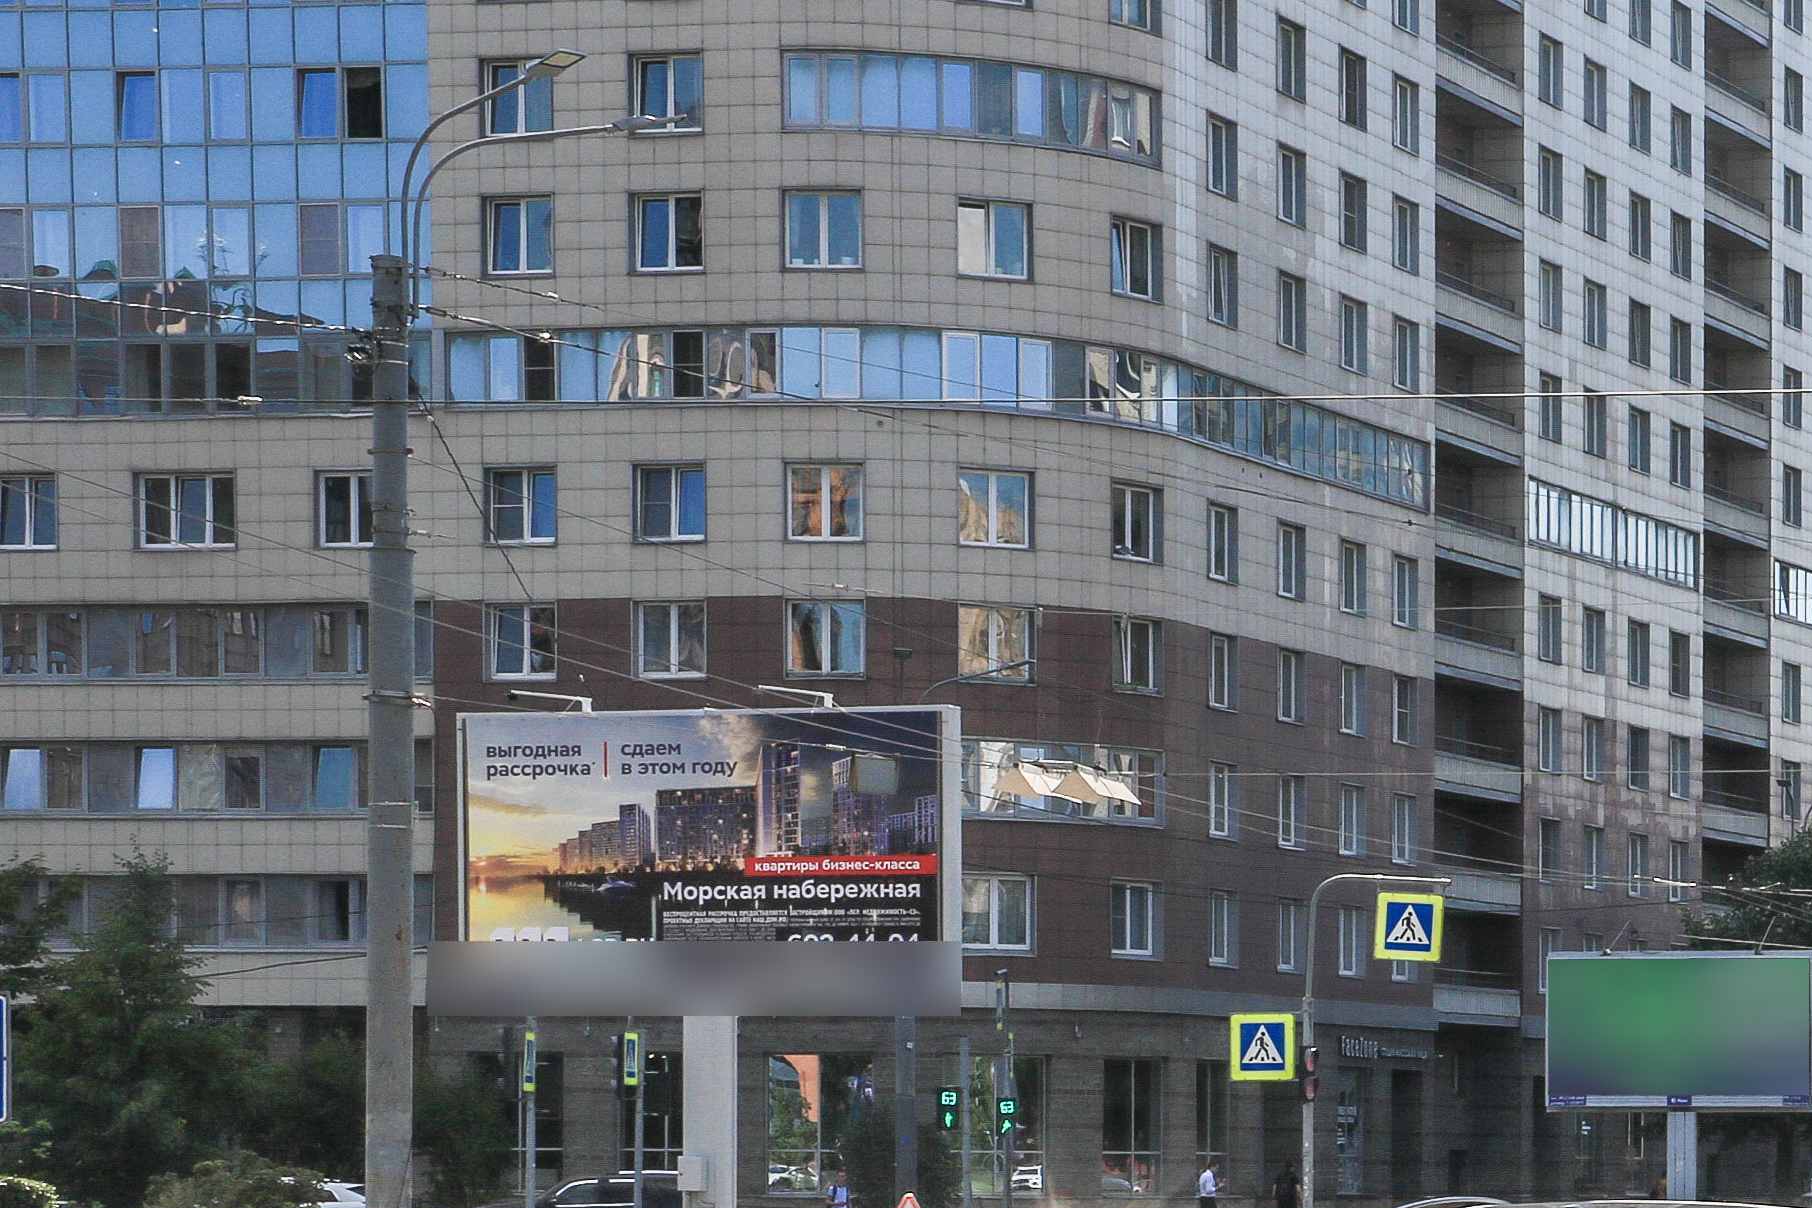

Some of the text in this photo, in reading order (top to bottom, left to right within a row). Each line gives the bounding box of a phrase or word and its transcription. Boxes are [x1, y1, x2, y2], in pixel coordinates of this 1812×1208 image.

[486, 744, 582, 759] выгодная
[621, 742, 682, 758] сдаем
[621, 760, 738, 778] в этом году
[755, 859, 920, 873] квартиры бизнес-класса
[663, 879, 921, 904] Морская набережная
[941, 1091, 957, 1105] 63
[1000, 1101, 1014, 1114] 63
